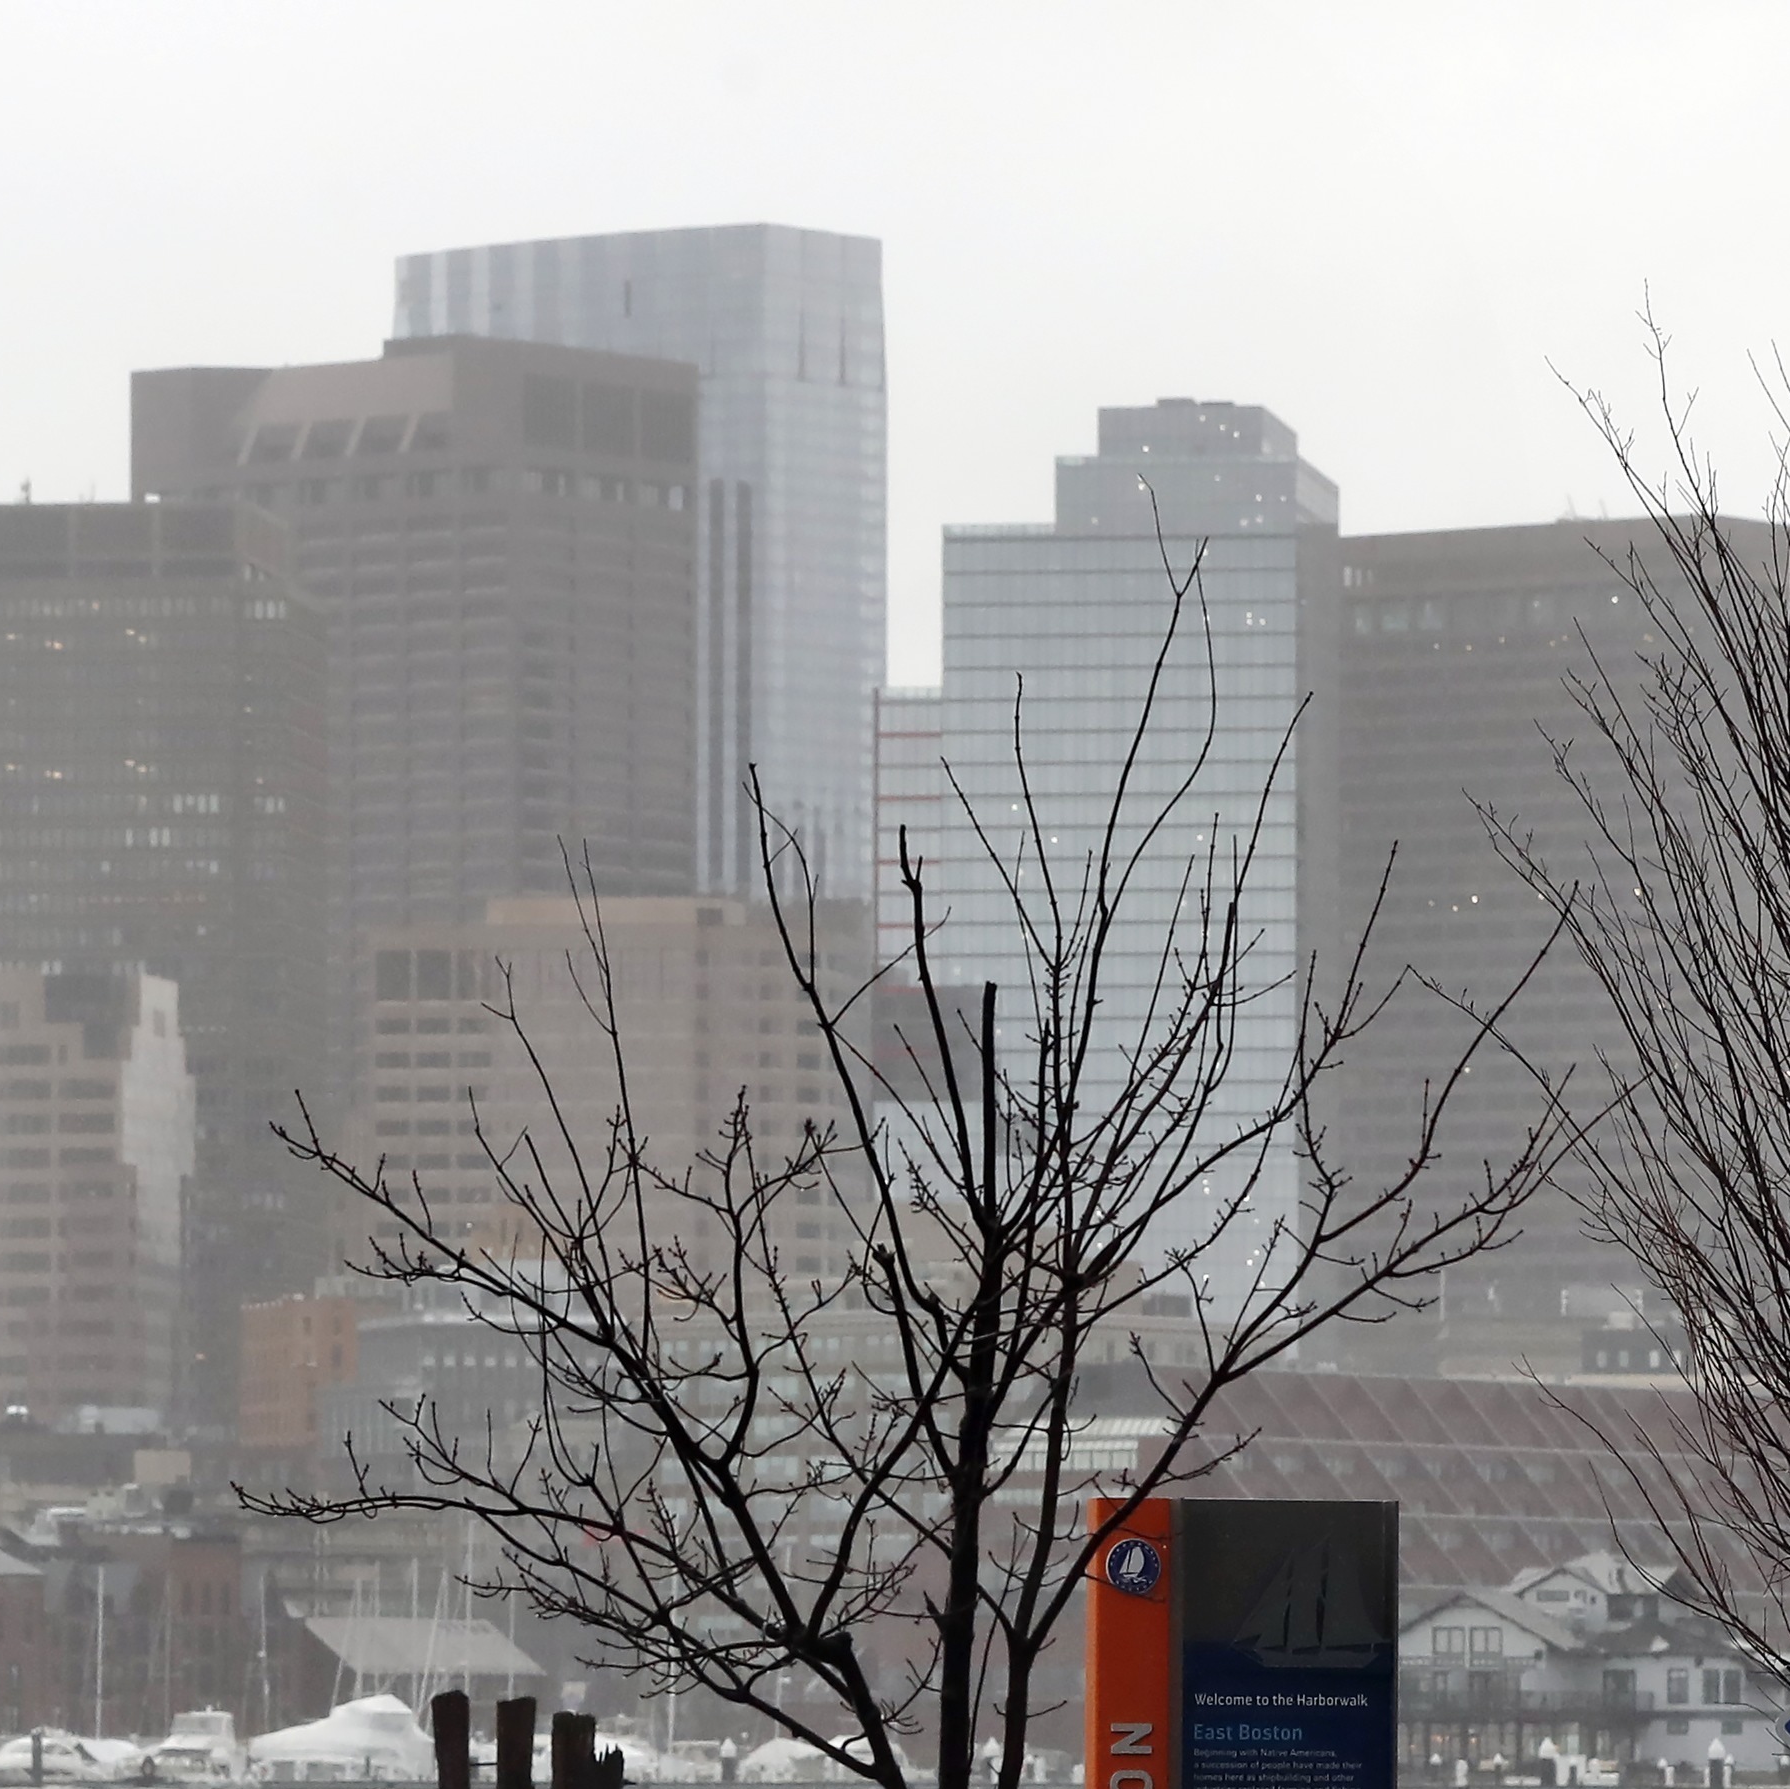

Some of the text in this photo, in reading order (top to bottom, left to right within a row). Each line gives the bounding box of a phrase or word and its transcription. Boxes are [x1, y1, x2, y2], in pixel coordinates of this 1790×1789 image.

[1194, 1693, 1369, 1706] Welcome to the Harborwalk
[1193, 1723, 1303, 1741] East Boston
